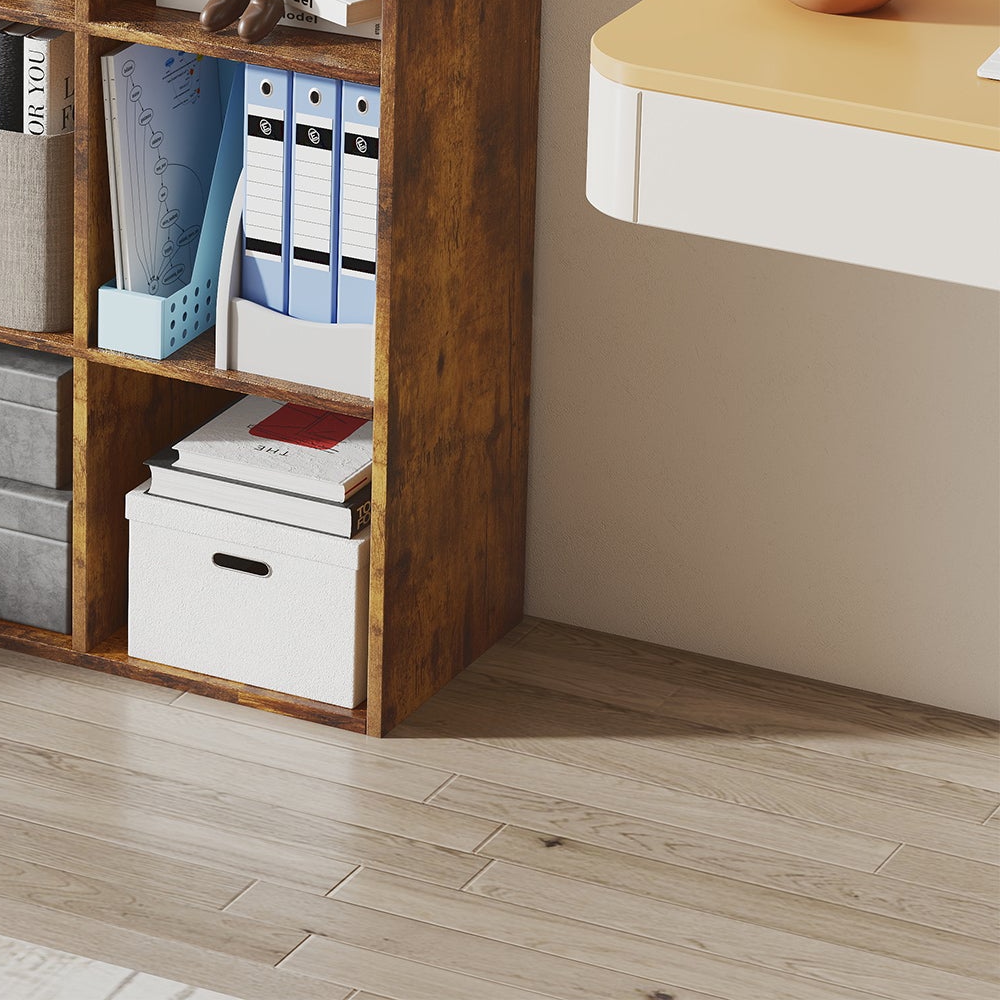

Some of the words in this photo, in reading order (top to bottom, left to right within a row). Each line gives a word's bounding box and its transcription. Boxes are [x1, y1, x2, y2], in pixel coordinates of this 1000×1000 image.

[283, 12, 318, 25] odel
[28, 49, 46, 94] YOU
[254, 444, 289, 457] THE
